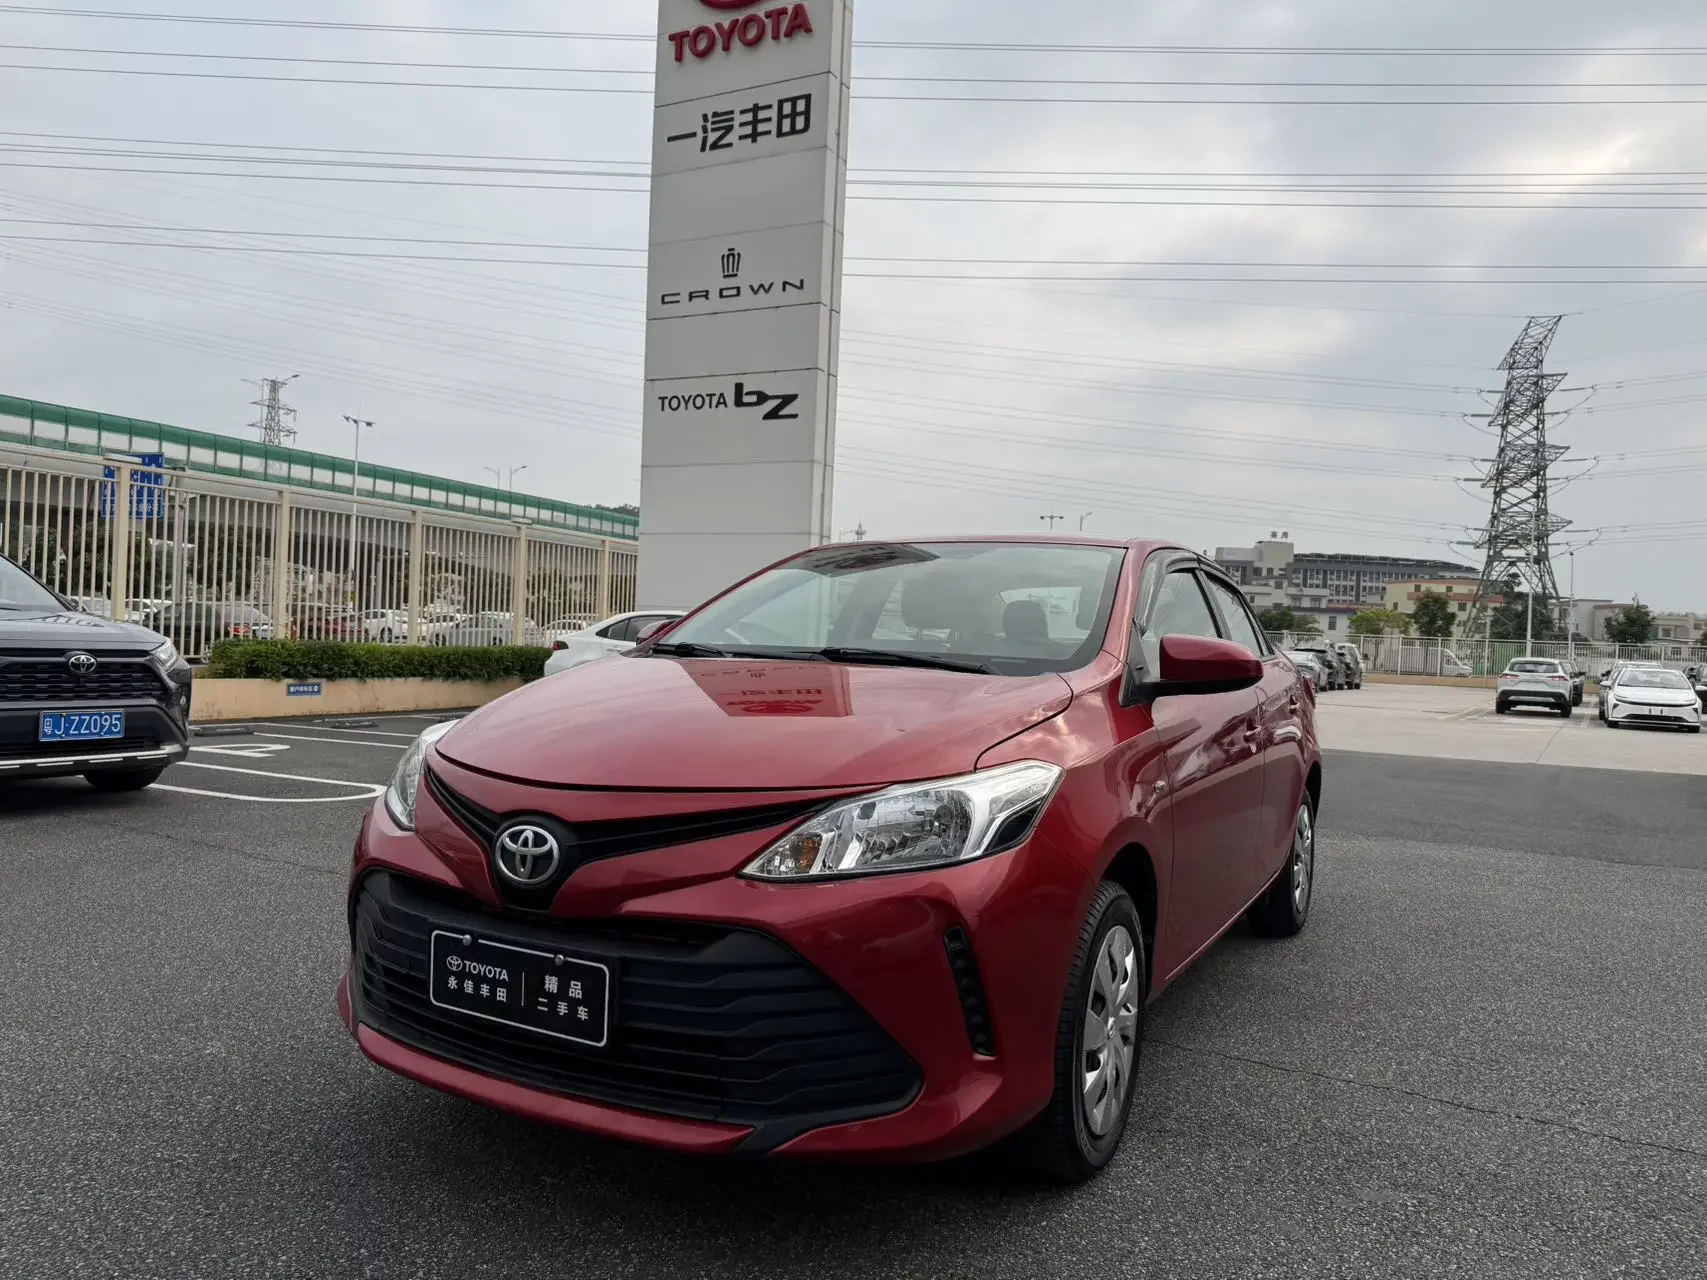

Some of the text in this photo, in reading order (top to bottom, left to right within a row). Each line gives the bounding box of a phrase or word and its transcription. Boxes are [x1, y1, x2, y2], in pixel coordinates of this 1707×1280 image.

[668, 3, 813, 62] TOYOTA
[667, 93, 812, 152] 一汽丰田
[661, 279, 804, 305] CROWN
[658, 392, 728, 412] TOYOTA
[464, 960, 508, 982] TOYOTA
[448, 976, 507, 1003] 永佳丰田
[544, 974, 583, 1000] 精品
[537, 997, 589, 1022] 二手车
